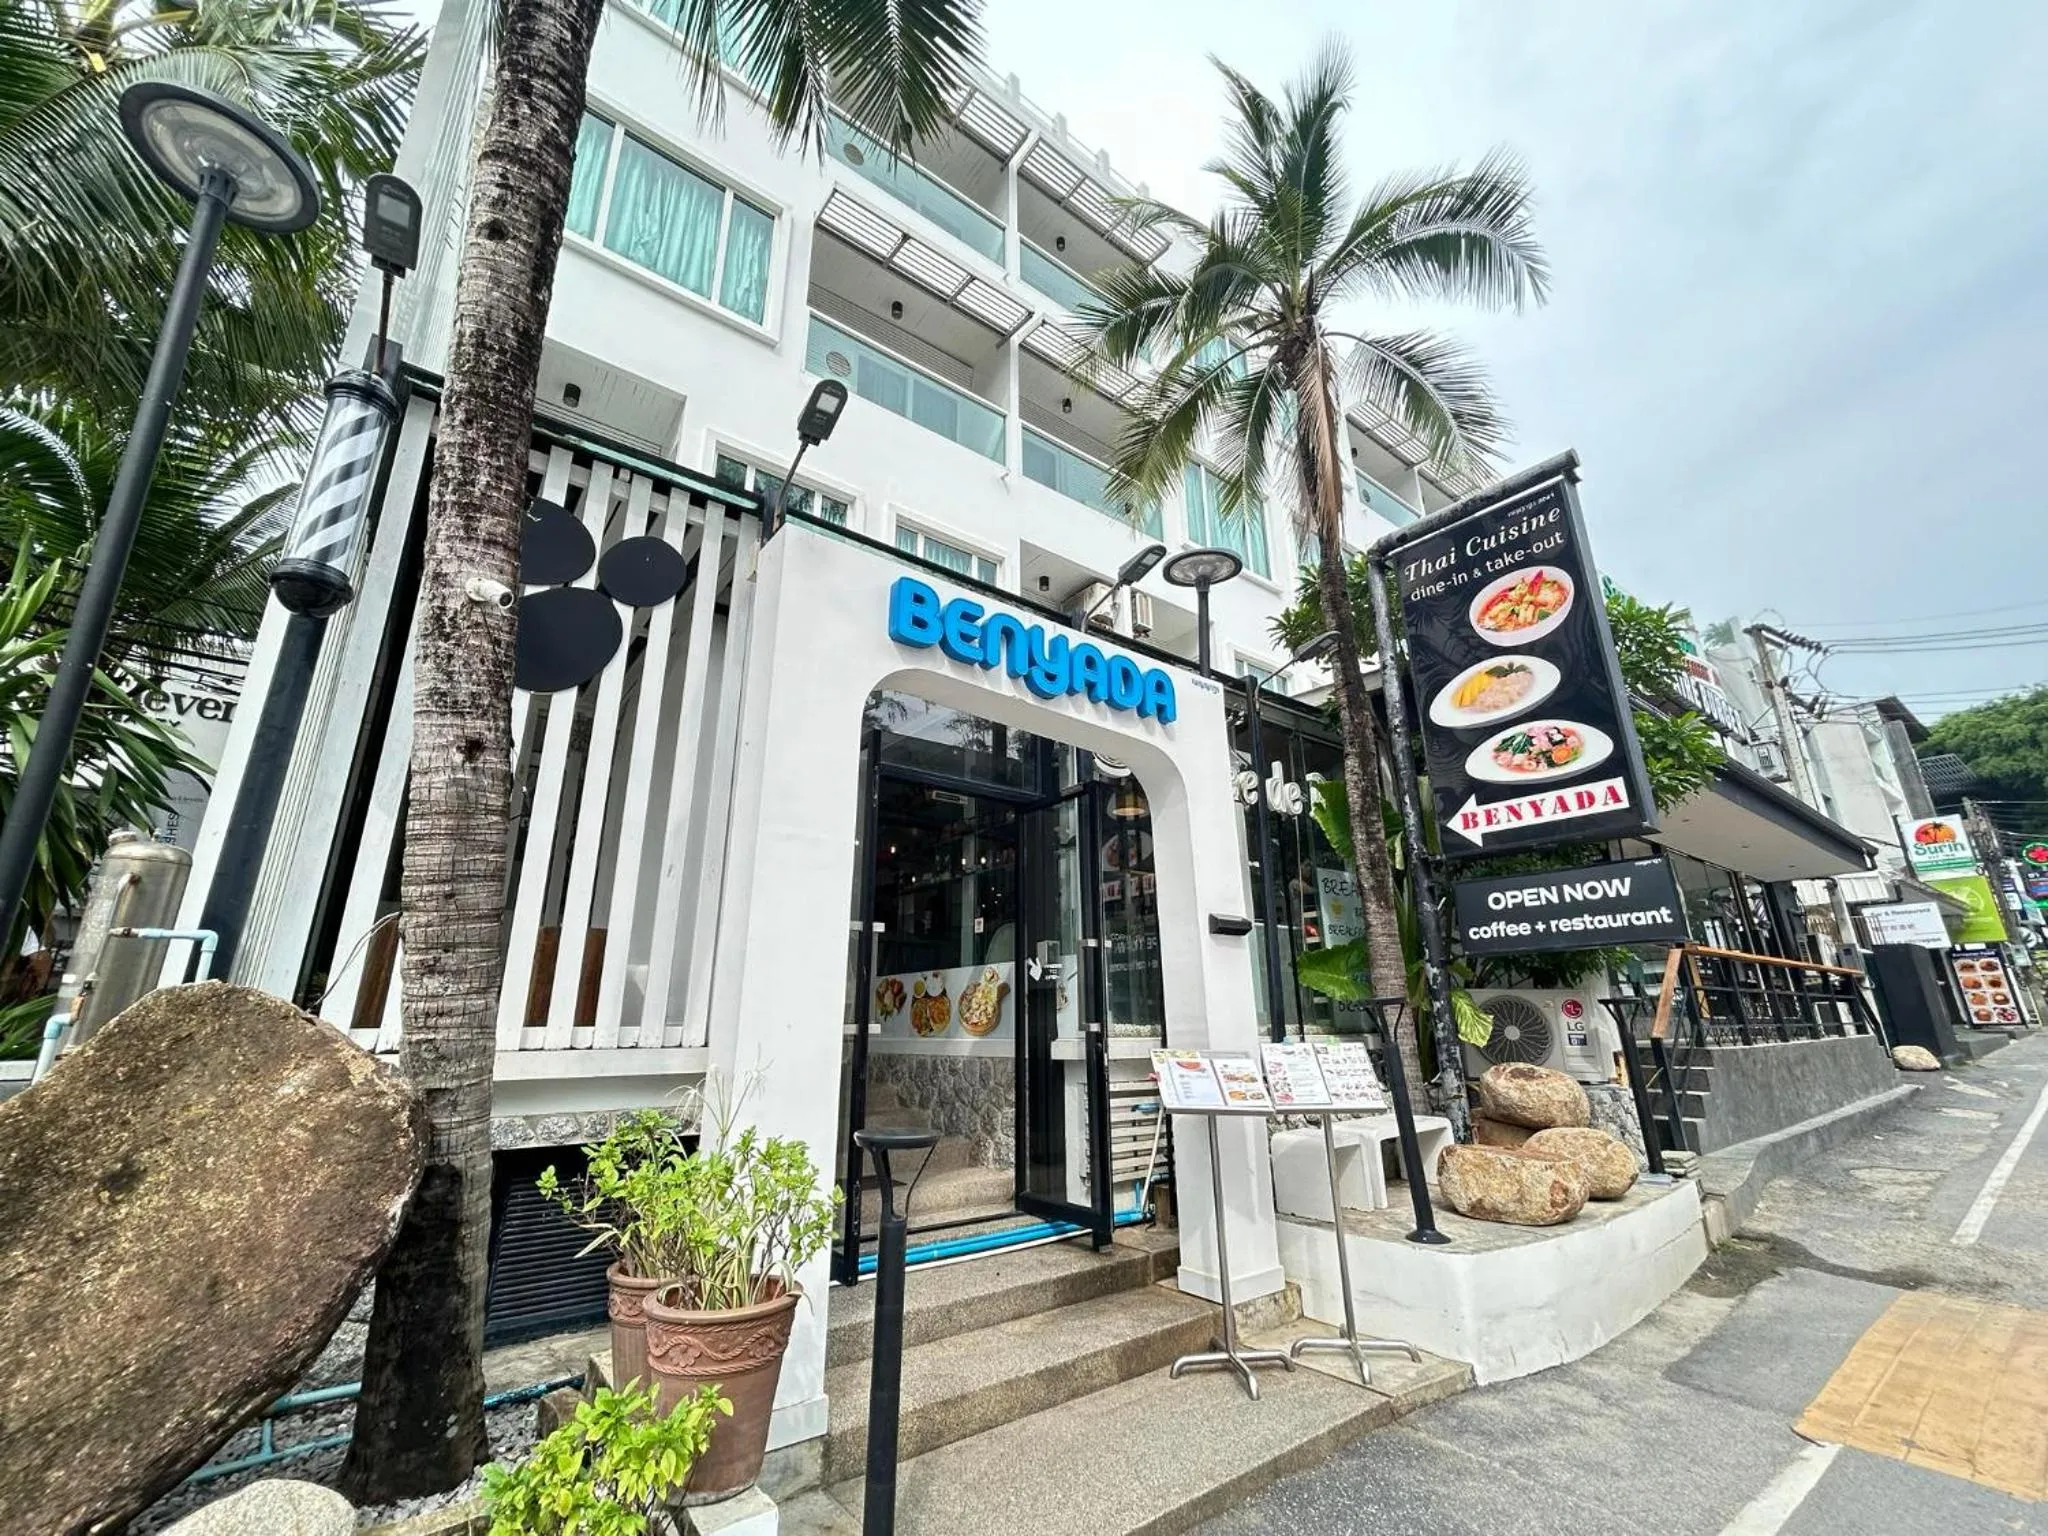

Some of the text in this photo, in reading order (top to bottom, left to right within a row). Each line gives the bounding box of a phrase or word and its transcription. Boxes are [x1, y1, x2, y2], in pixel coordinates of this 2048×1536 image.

[1404, 507, 1561, 582] Thai Cuisine
[1411, 532, 1565, 601] dine-in & take-out
[889, 576, 1177, 725] BENYADA
[1460, 784, 1623, 830] BENYADA
[1913, 842, 1965, 856] Surin
[1487, 877, 1631, 910] OPEN NOW
[1468, 906, 1674, 940] coffee + restaurant
[1566, 1022, 1585, 1031] LG
